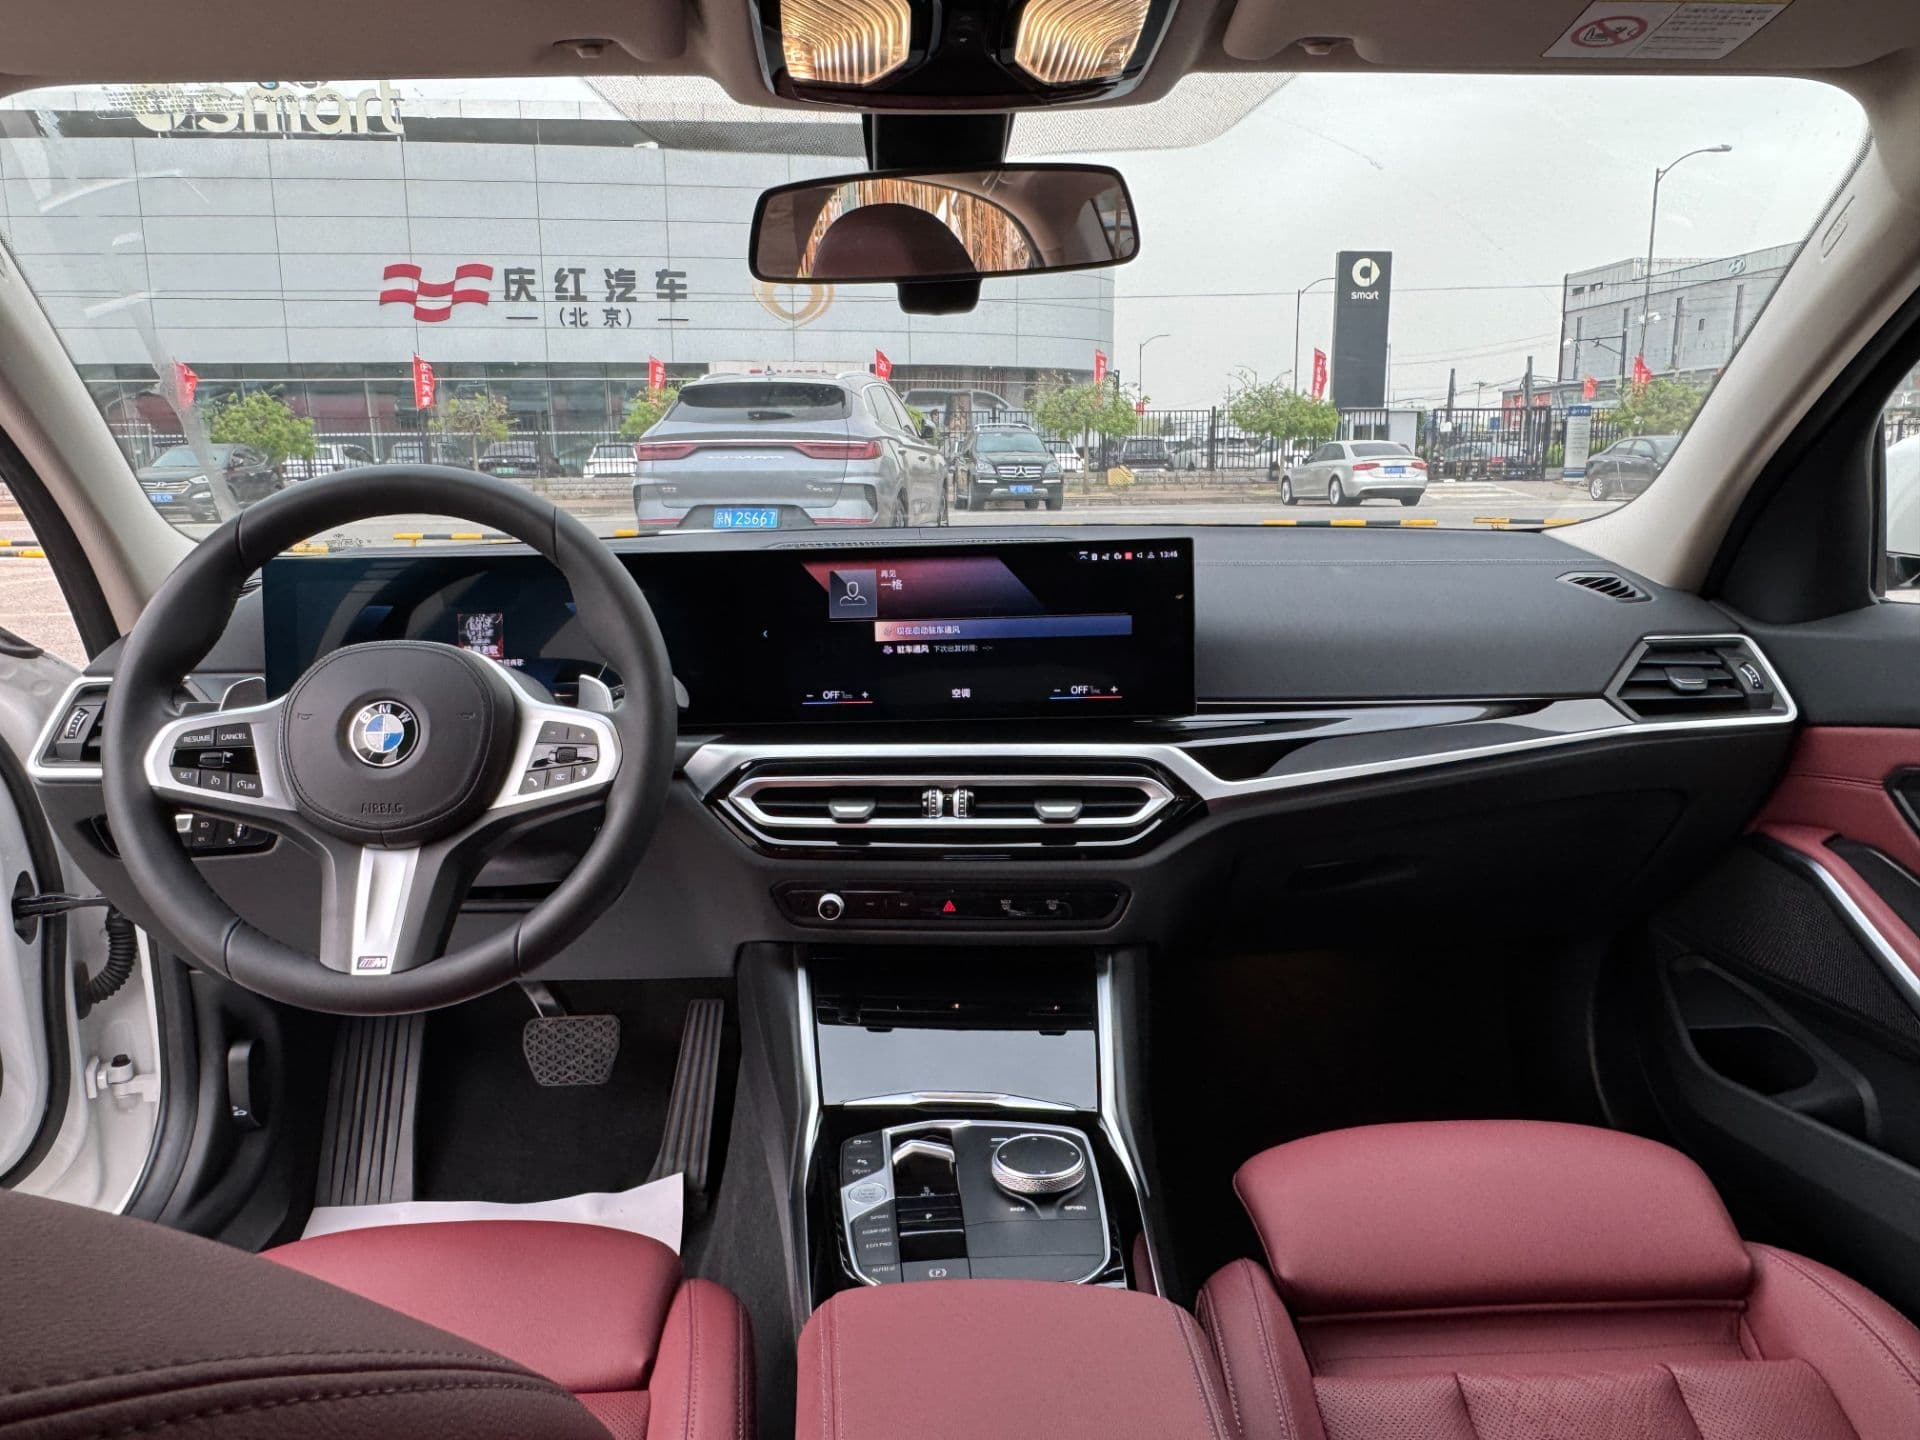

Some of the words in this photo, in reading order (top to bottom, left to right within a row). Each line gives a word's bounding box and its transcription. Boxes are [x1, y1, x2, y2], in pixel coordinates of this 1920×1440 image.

[199, 81, 404, 133] smart
[503, 267, 688, 302] 庆红汽车
[1351, 291, 1379, 300] smart
[559, 306, 632, 328] (北京)
[881, 570, 896, 578] 再见
[881, 579, 903, 590] 一格
[952, 688, 971, 699] 空调
[1071, 685, 1089, 694] OFF
[823, 690, 840, 700] OFF
[184, 735, 211, 743] RESUME
[221, 733, 247, 741] CANCEL
[361, 803, 402, 813] AIRBAG
